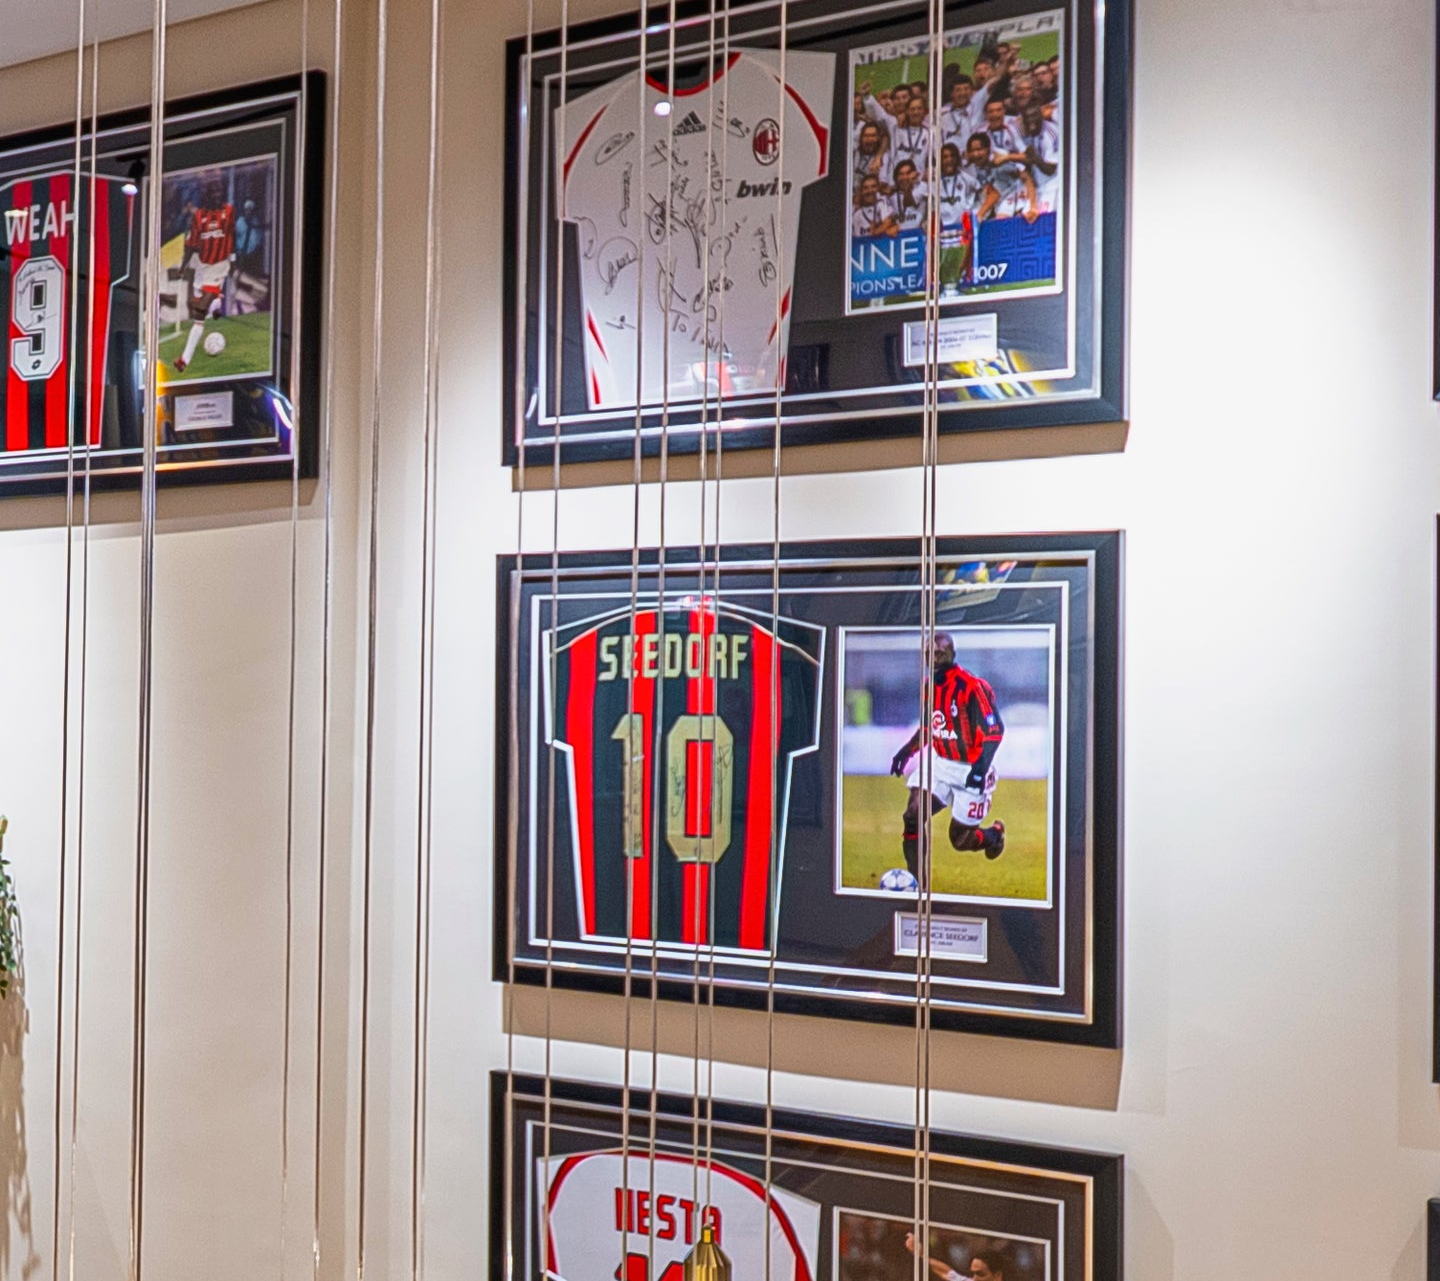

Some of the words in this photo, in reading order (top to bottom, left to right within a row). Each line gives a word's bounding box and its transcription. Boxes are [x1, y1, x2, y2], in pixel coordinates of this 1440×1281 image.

[736, 177, 792, 199] bwin
[4, 200, 77, 246] WEAH
[975, 262, 1008, 281] 007
[10, 255, 66, 382] 9
[598, 633, 750, 681] SEEDORF
[610, 713, 734, 862] 10
[614, 1187, 723, 1247] NESTA
